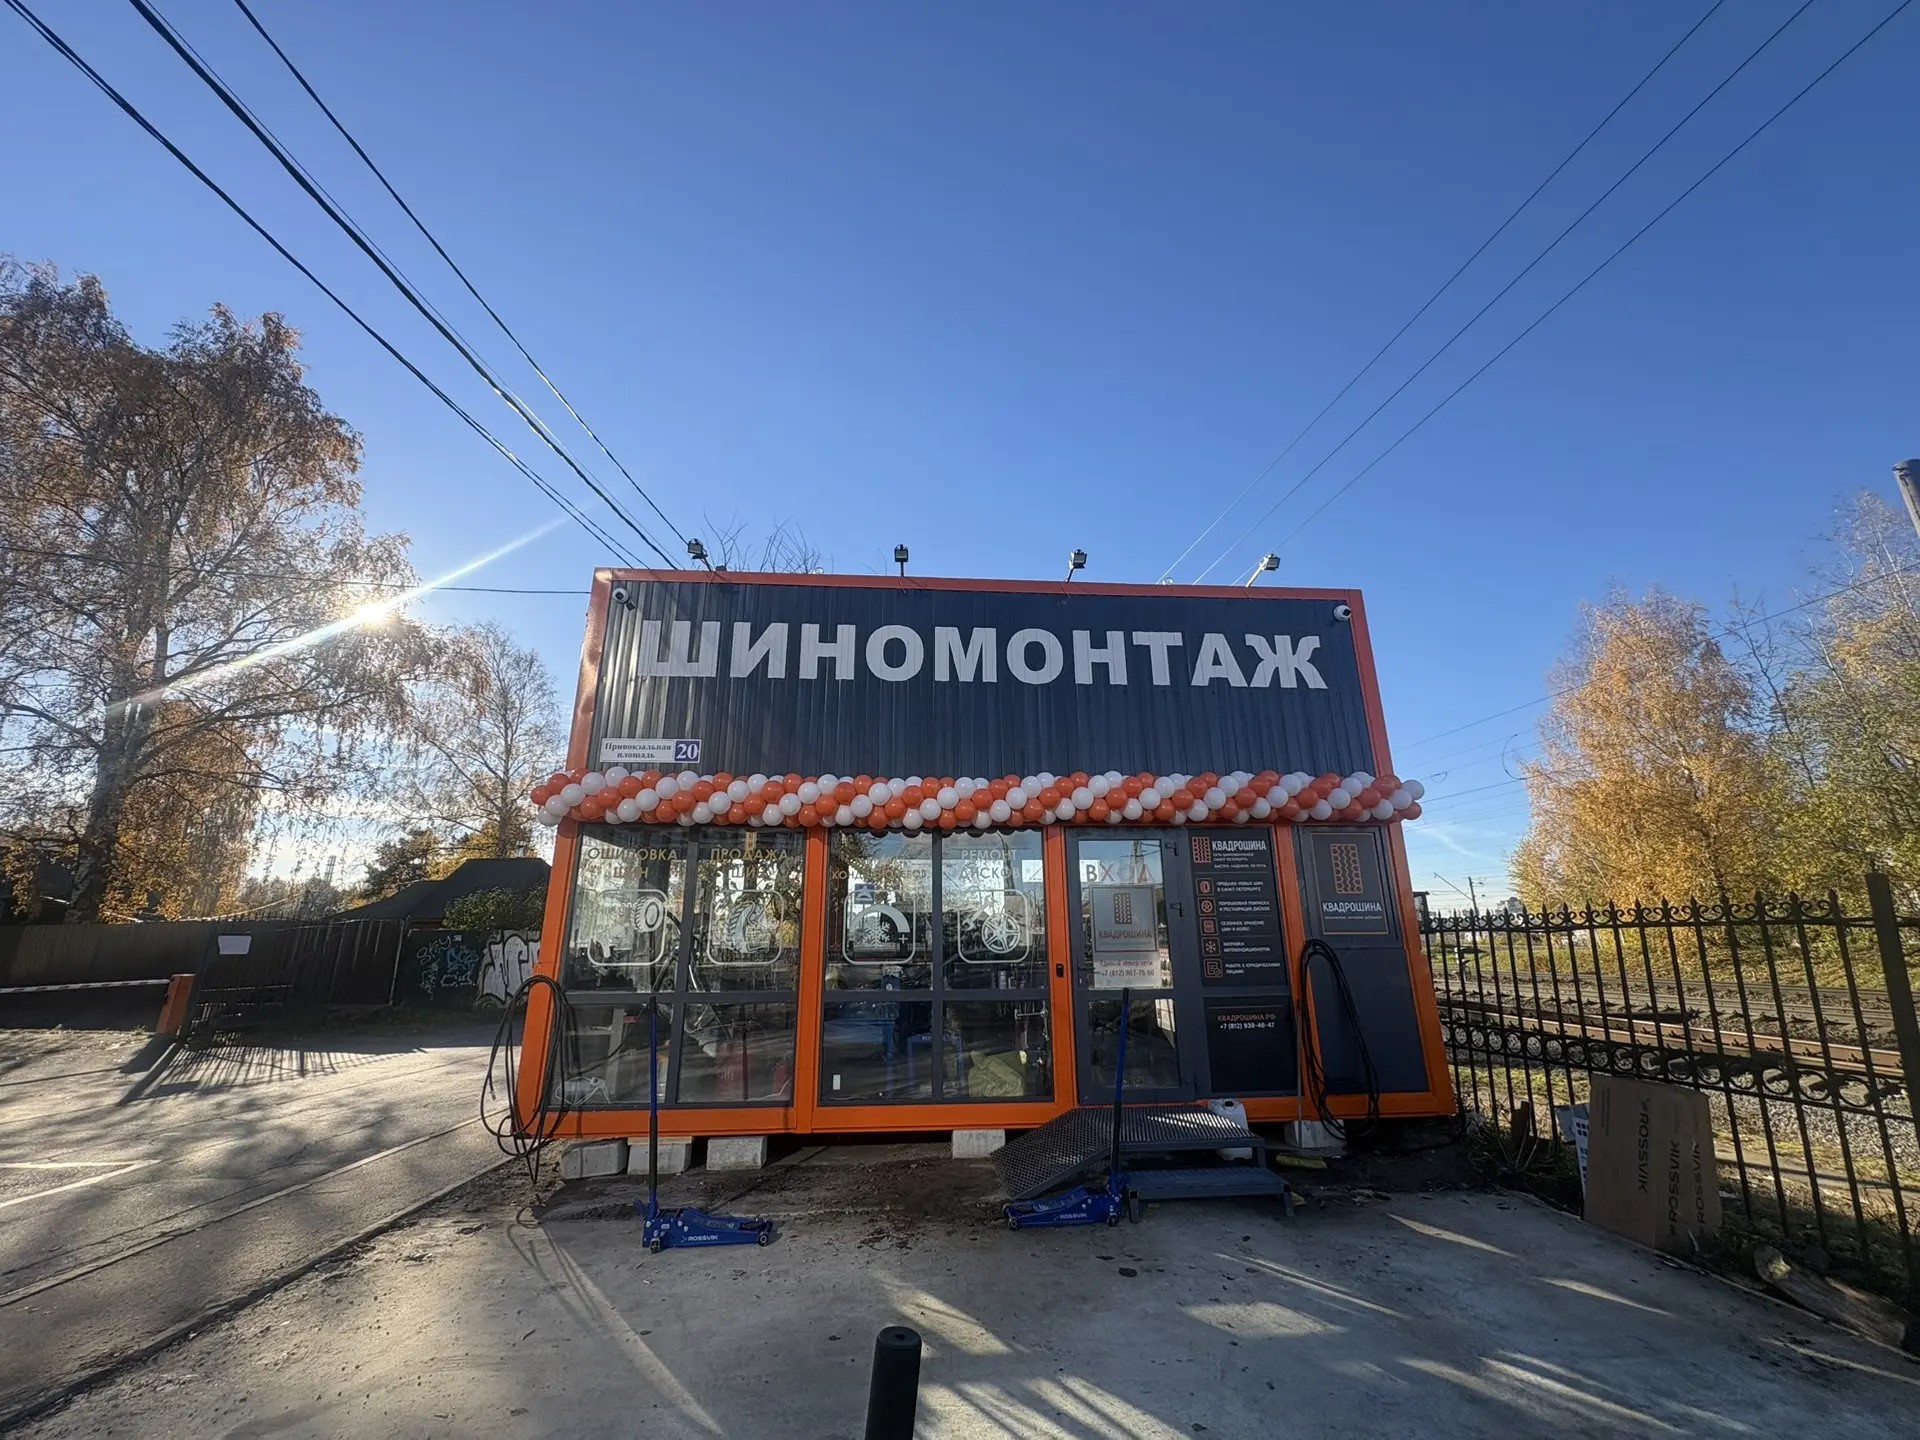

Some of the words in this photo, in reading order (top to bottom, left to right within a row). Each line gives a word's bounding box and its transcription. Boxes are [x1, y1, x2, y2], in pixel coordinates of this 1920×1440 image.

[637, 620, 1328, 689] ШИНОМОНТАЖ
[604, 742, 672, 752] Привокзальная
[675, 743, 699, 759] 20
[1212, 840, 1267, 851] КВАДРОШИНА
[710, 848, 788, 861] ПРОДАЖА
[961, 849, 1017, 860] РЕМОНТ
[1322, 902, 1382, 913] КВАДРОШИНА
[1098, 929, 1153, 939] КВАДРОШИНА
[1638, 1112, 1649, 1194] ROSSVIK
[1667, 1139, 1681, 1222] ROSSVIK
[687, 1234, 719, 1242] ROSSVIK
